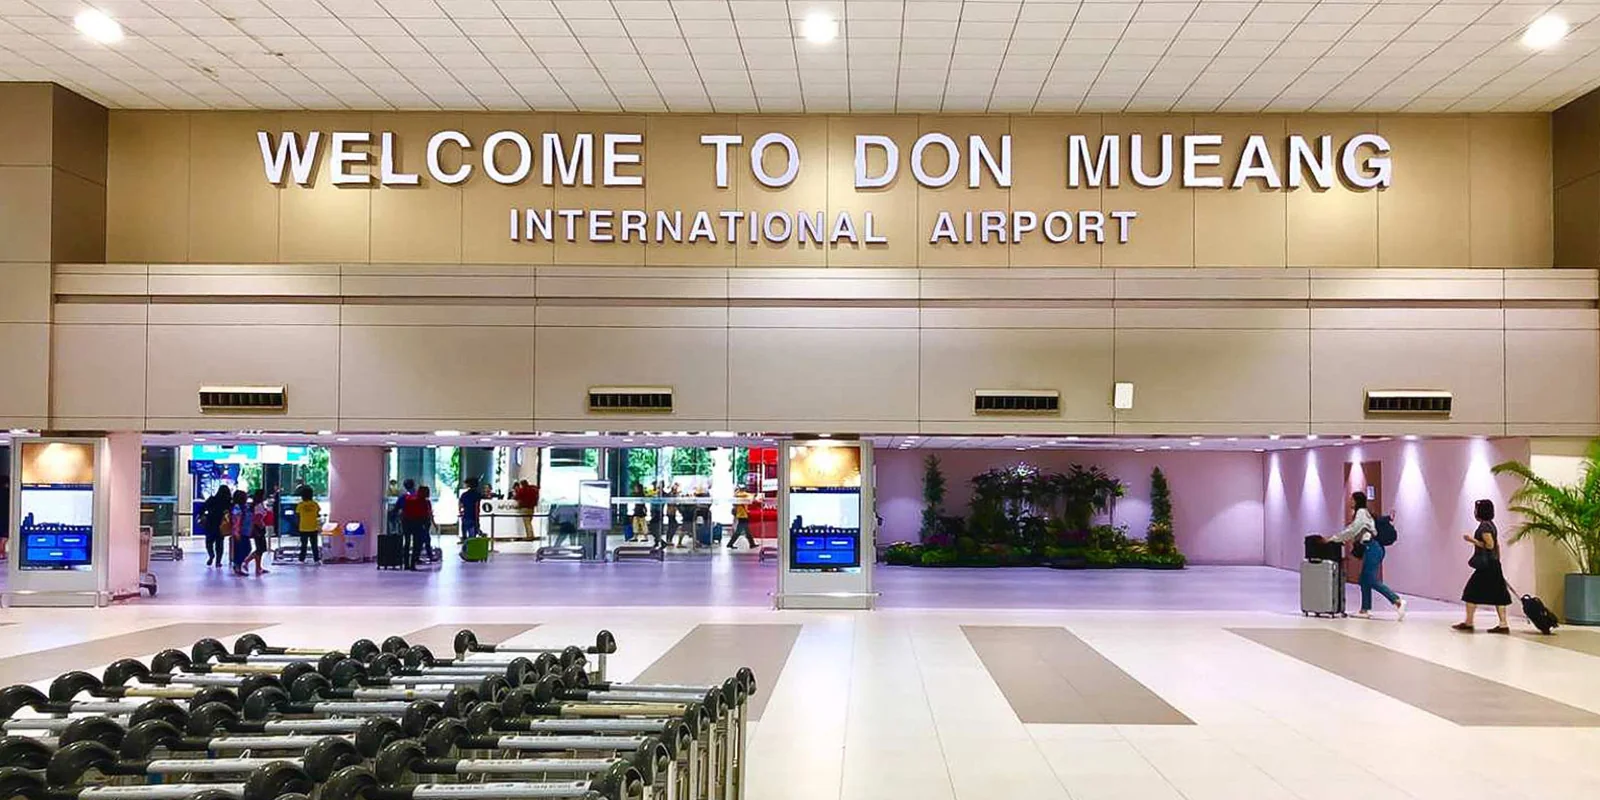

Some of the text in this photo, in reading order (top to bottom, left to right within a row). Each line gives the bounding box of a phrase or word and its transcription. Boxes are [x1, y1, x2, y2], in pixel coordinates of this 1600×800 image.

[256, 131, 1393, 190] WELCOME TO DON MUEANG
[509, 209, 1138, 244] INTERNATIONAL AIRPORT
